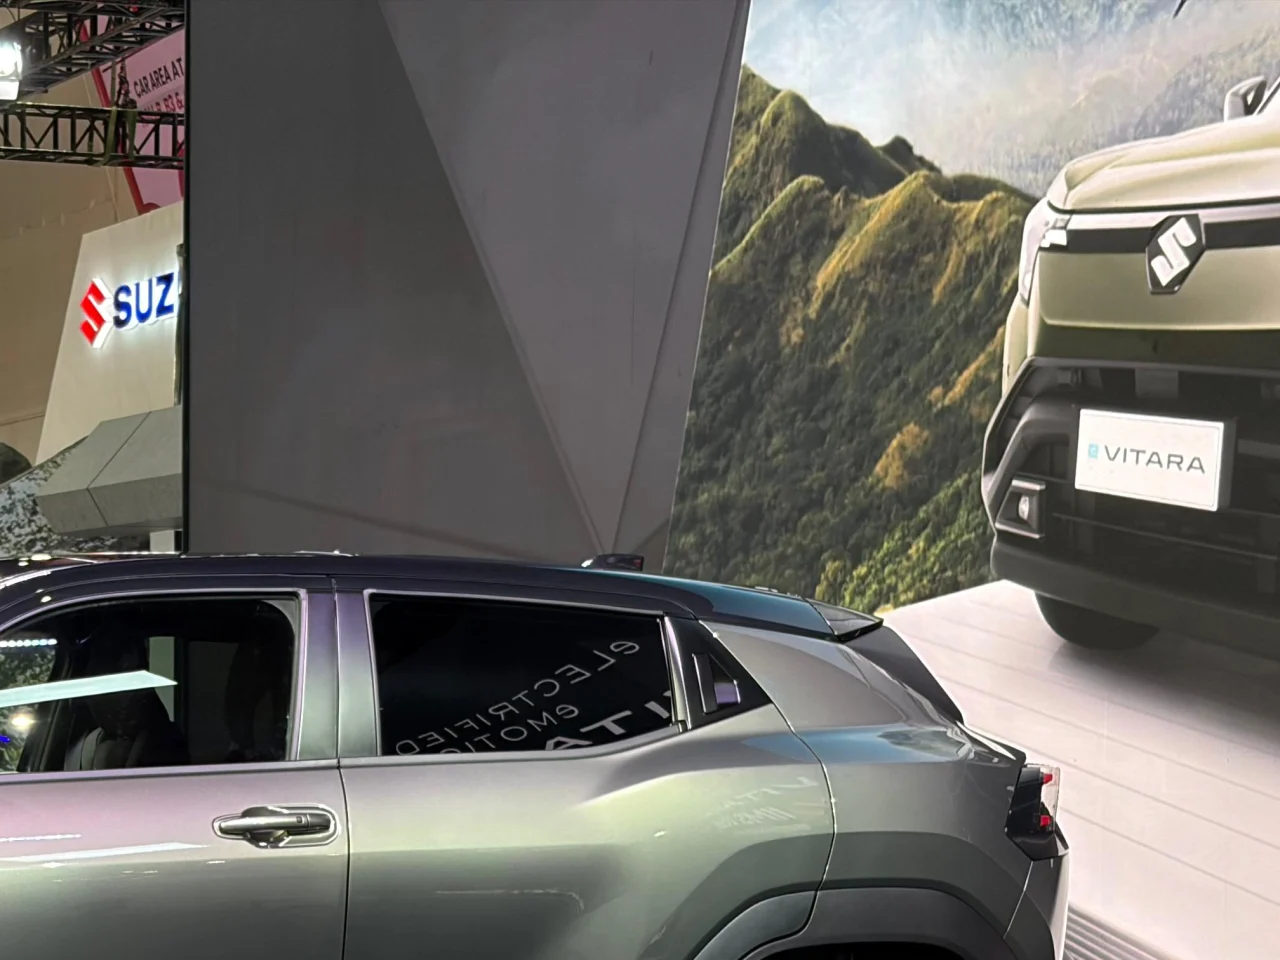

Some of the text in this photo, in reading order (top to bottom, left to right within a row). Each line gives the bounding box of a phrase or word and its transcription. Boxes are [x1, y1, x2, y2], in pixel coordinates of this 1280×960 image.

[133, 75, 152, 98] CAR
[149, 65, 172, 91] AREA
[113, 271, 180, 331] SUZ
[1104, 444, 1206, 475] VITARA
